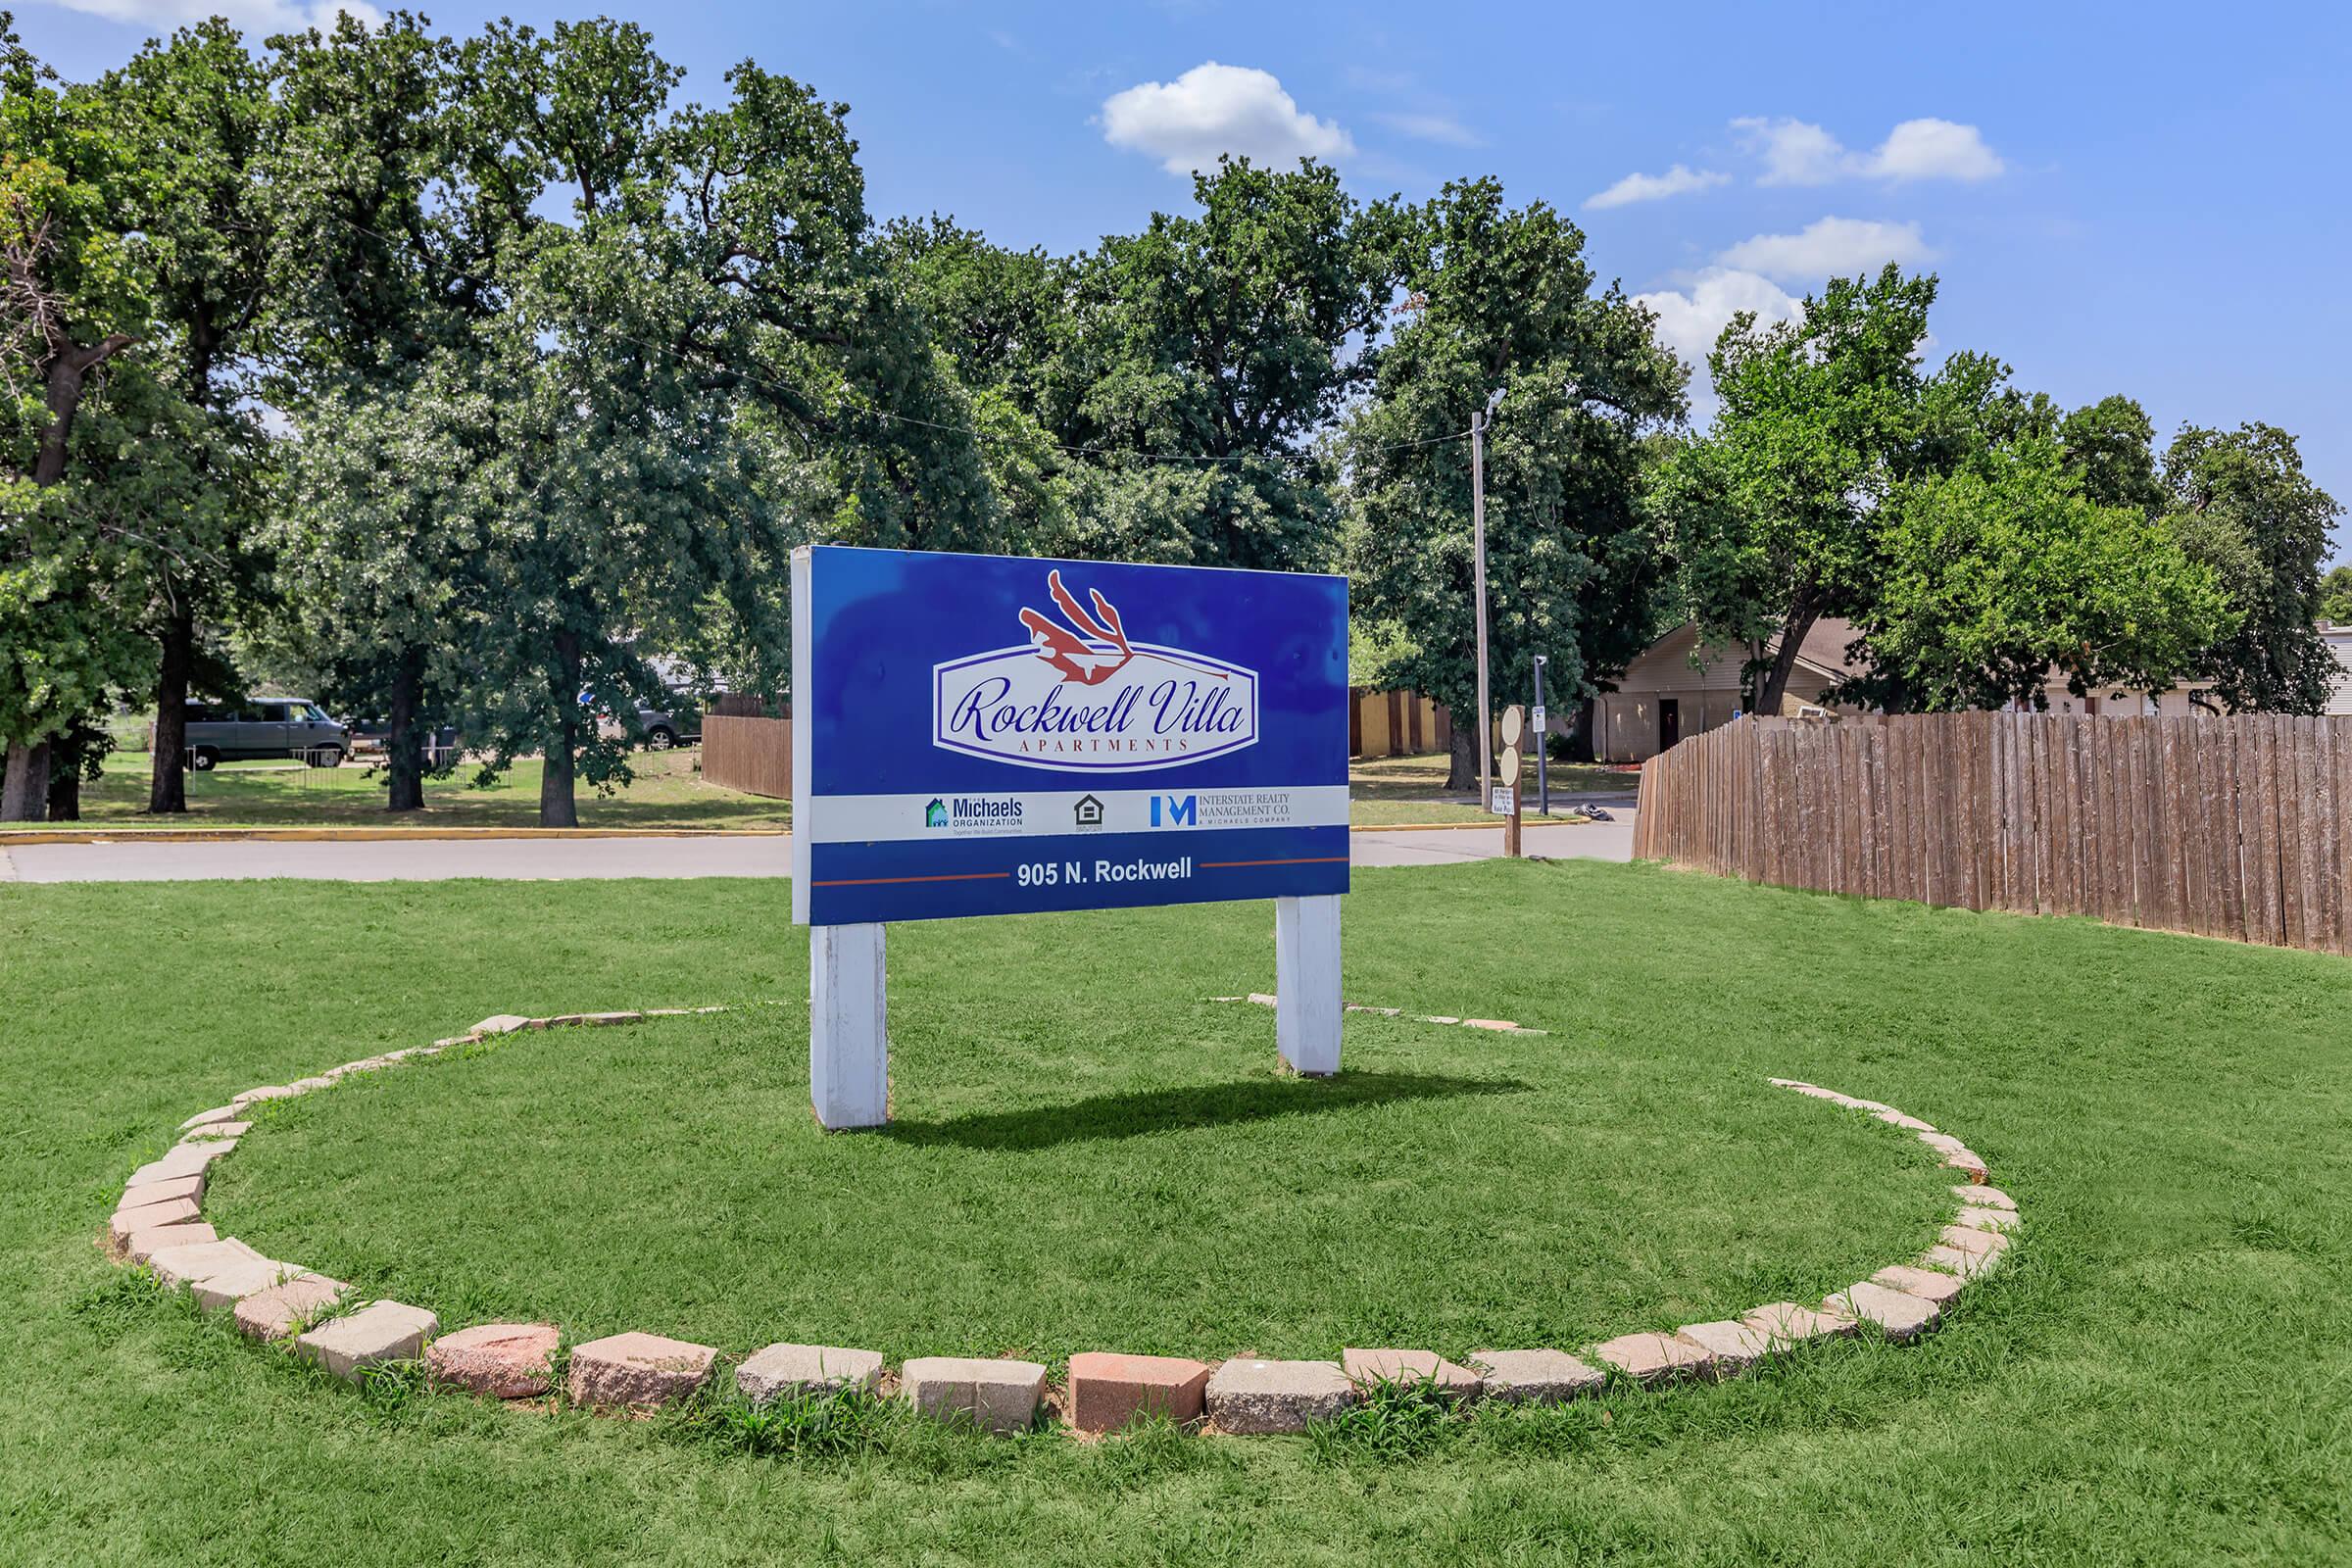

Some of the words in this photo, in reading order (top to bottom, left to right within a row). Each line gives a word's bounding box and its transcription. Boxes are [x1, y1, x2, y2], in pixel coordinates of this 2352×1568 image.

[950, 677, 1145, 742] Rockwell
[1149, 680, 1245, 735] Villa
[1019, 738, 1189, 753] APARTMENTS
[953, 798, 1023, 817] Michaels
[1200, 795, 1254, 806] INTERSTATE
[1256, 794, 1290, 805] REALTY
[1200, 806, 1271, 816] MANAGEMENT
[1273, 805, 1290, 815] CO.
[953, 818, 1023, 828] ORGANIZATION
[1017, 862, 1058, 887] 905
[1065, 861, 1087, 884] N.
[1095, 857, 1192, 882] Rockwell
